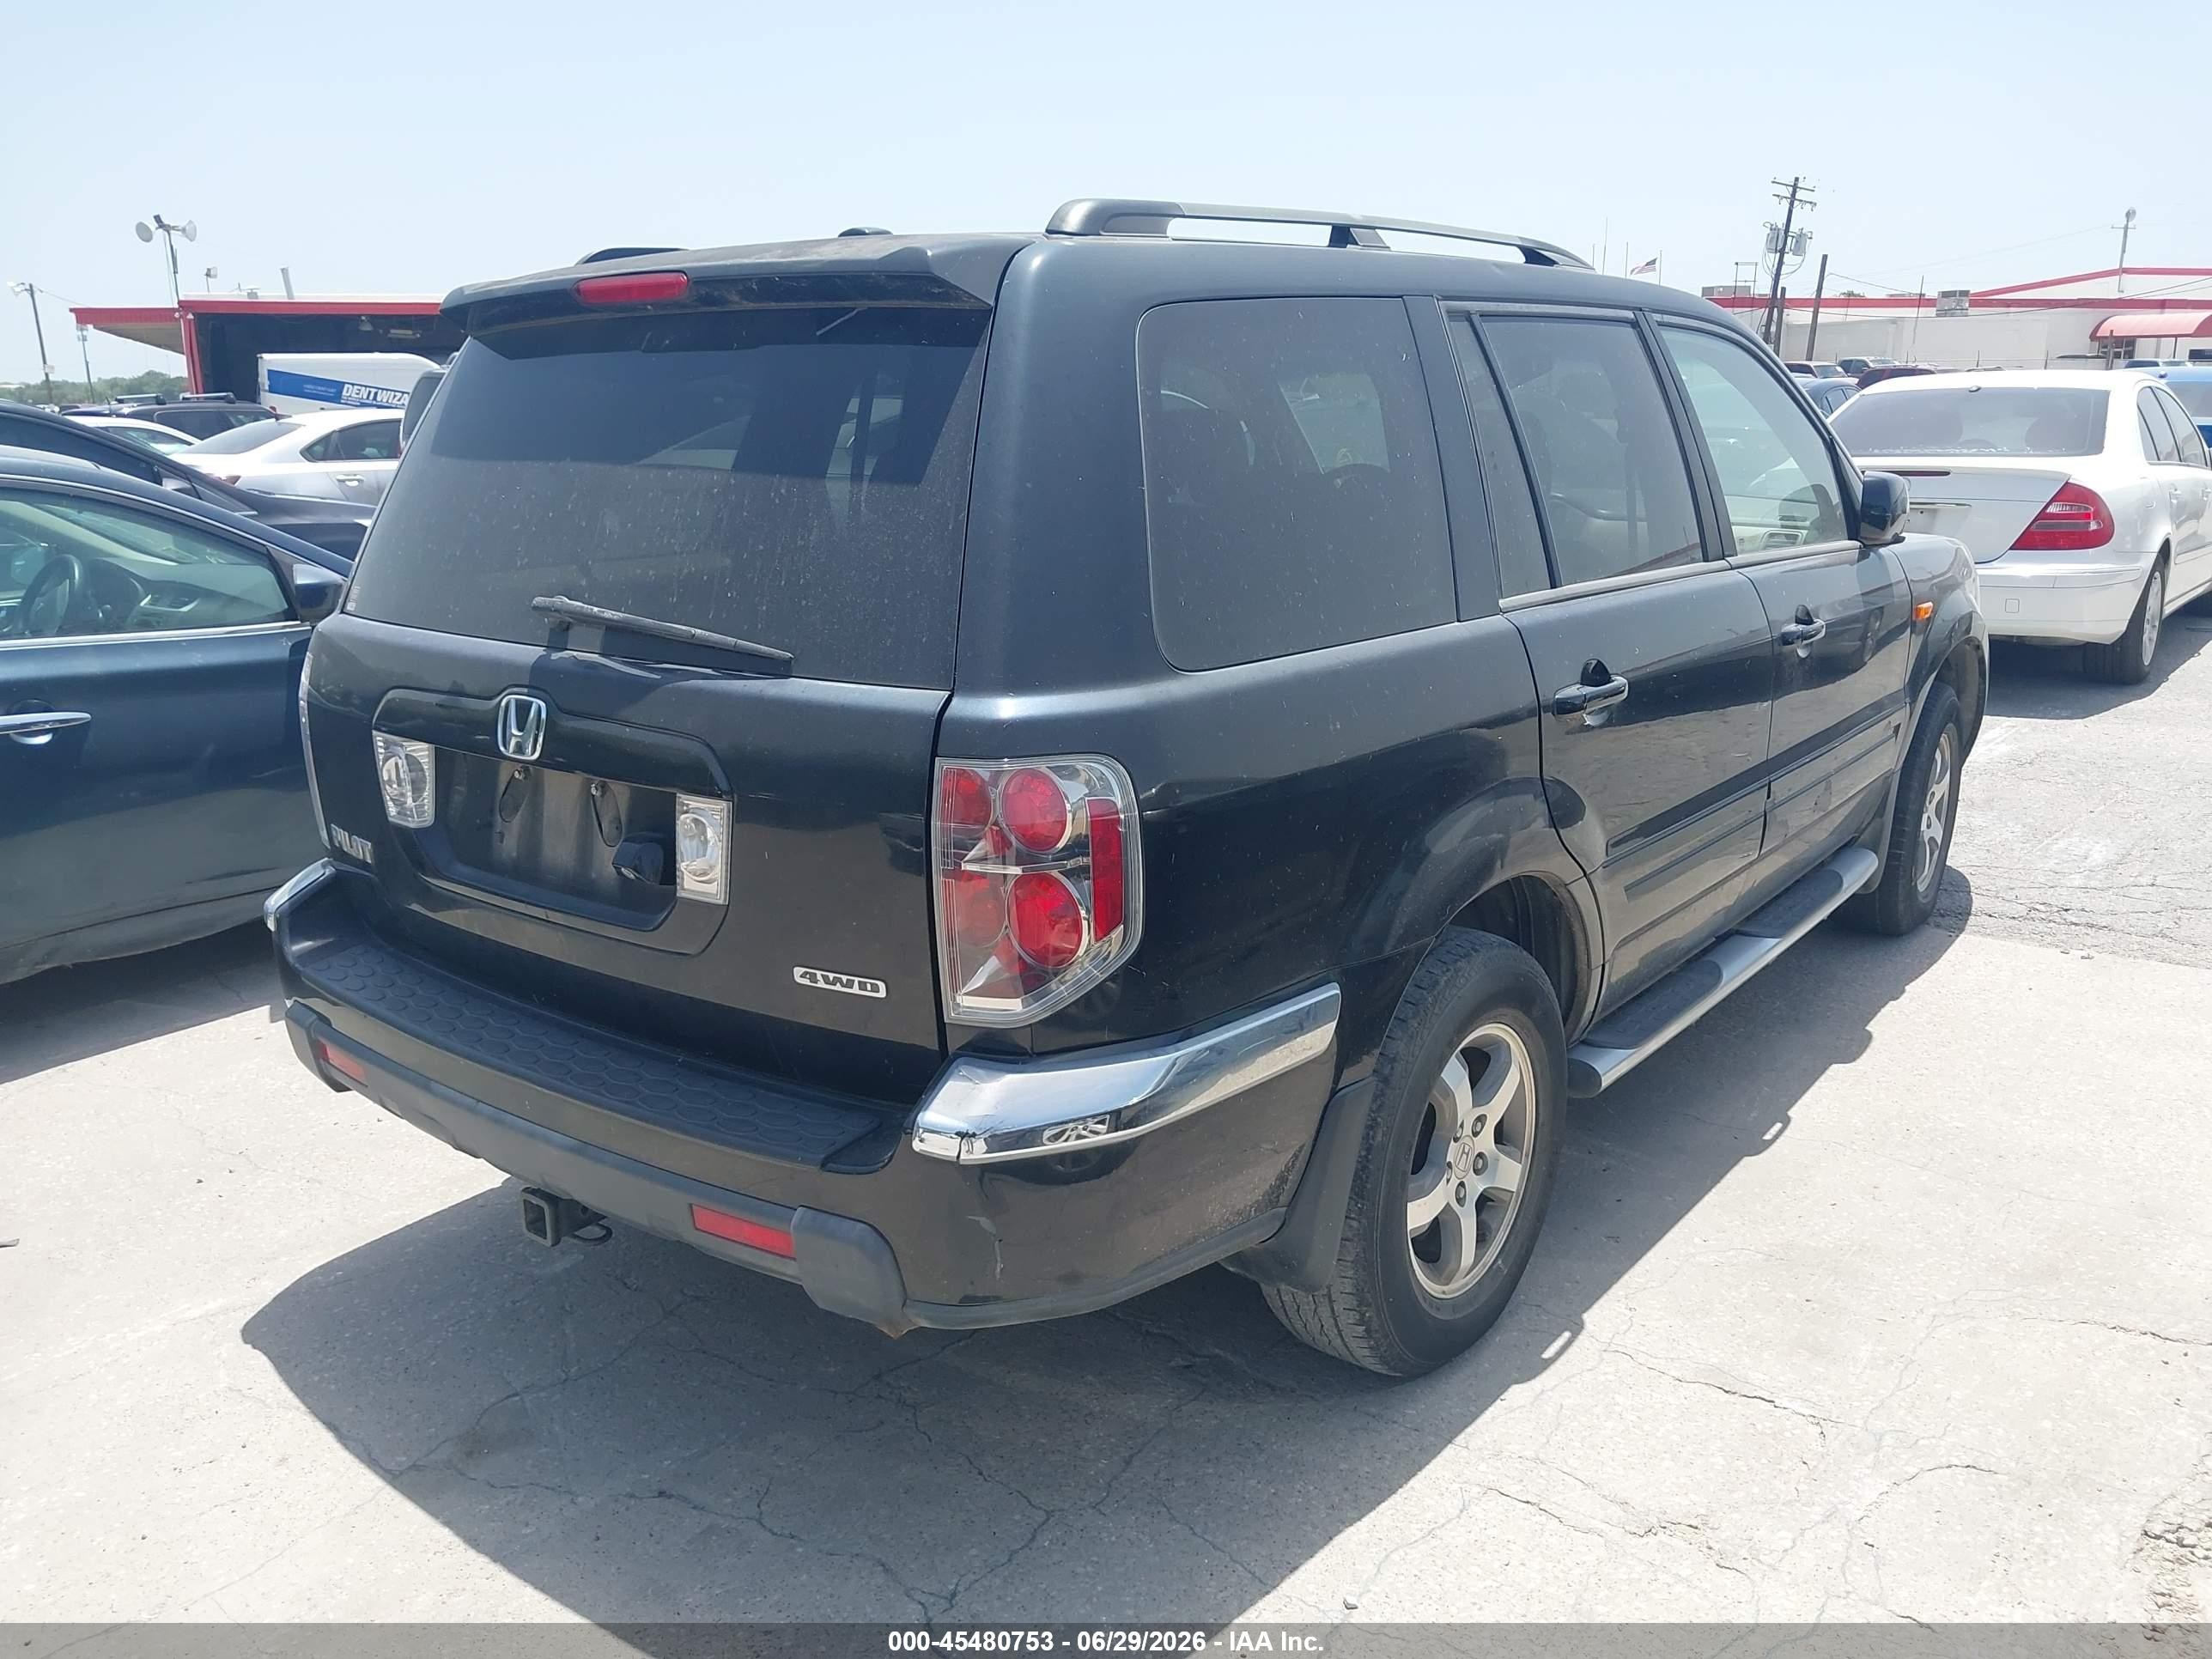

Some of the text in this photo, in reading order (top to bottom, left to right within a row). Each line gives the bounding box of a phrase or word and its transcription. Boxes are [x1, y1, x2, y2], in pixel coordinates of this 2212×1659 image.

[342, 383, 378, 400] DENT
[330, 823, 373, 864] PILOT
[799, 969, 881, 994] 4WD
